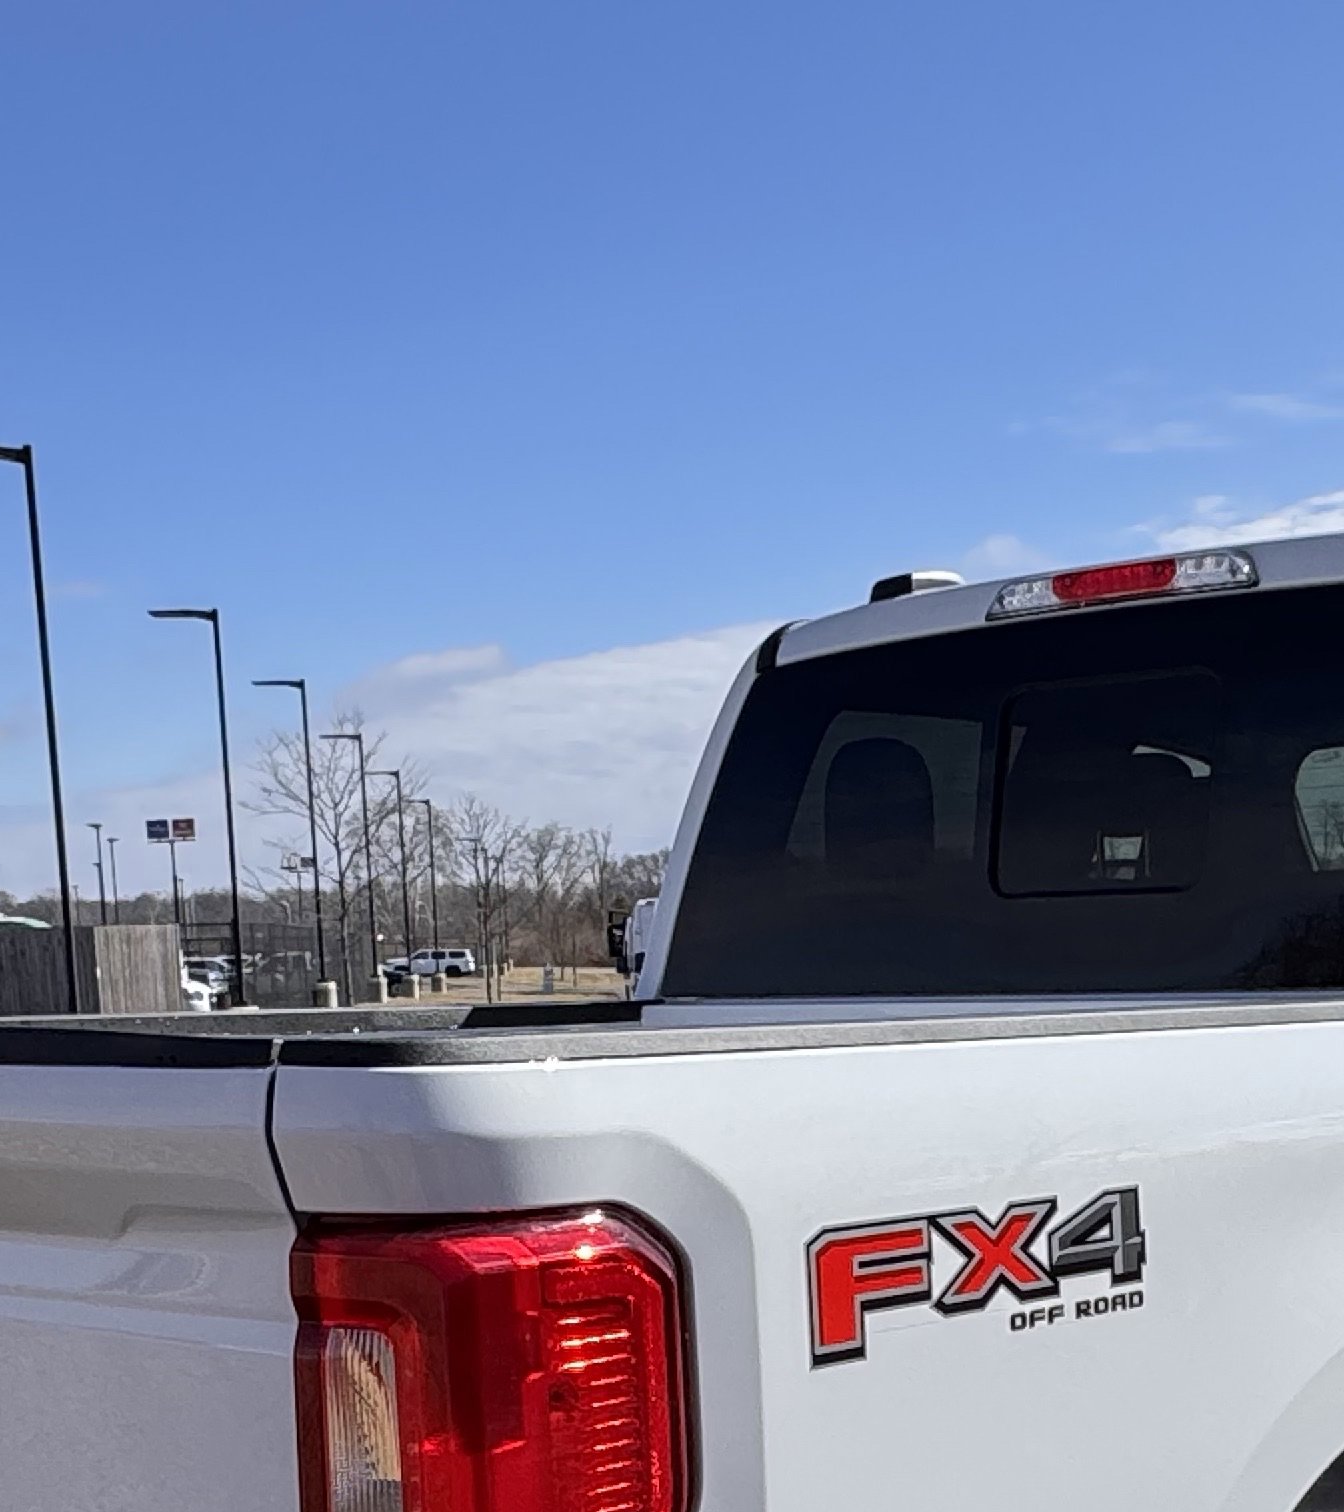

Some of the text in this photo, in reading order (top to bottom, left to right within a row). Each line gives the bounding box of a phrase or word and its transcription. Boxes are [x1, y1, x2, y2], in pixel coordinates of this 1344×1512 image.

[804, 1184, 1147, 1373] FX4
[1009, 1290, 1145, 1332] OFF ROAD
